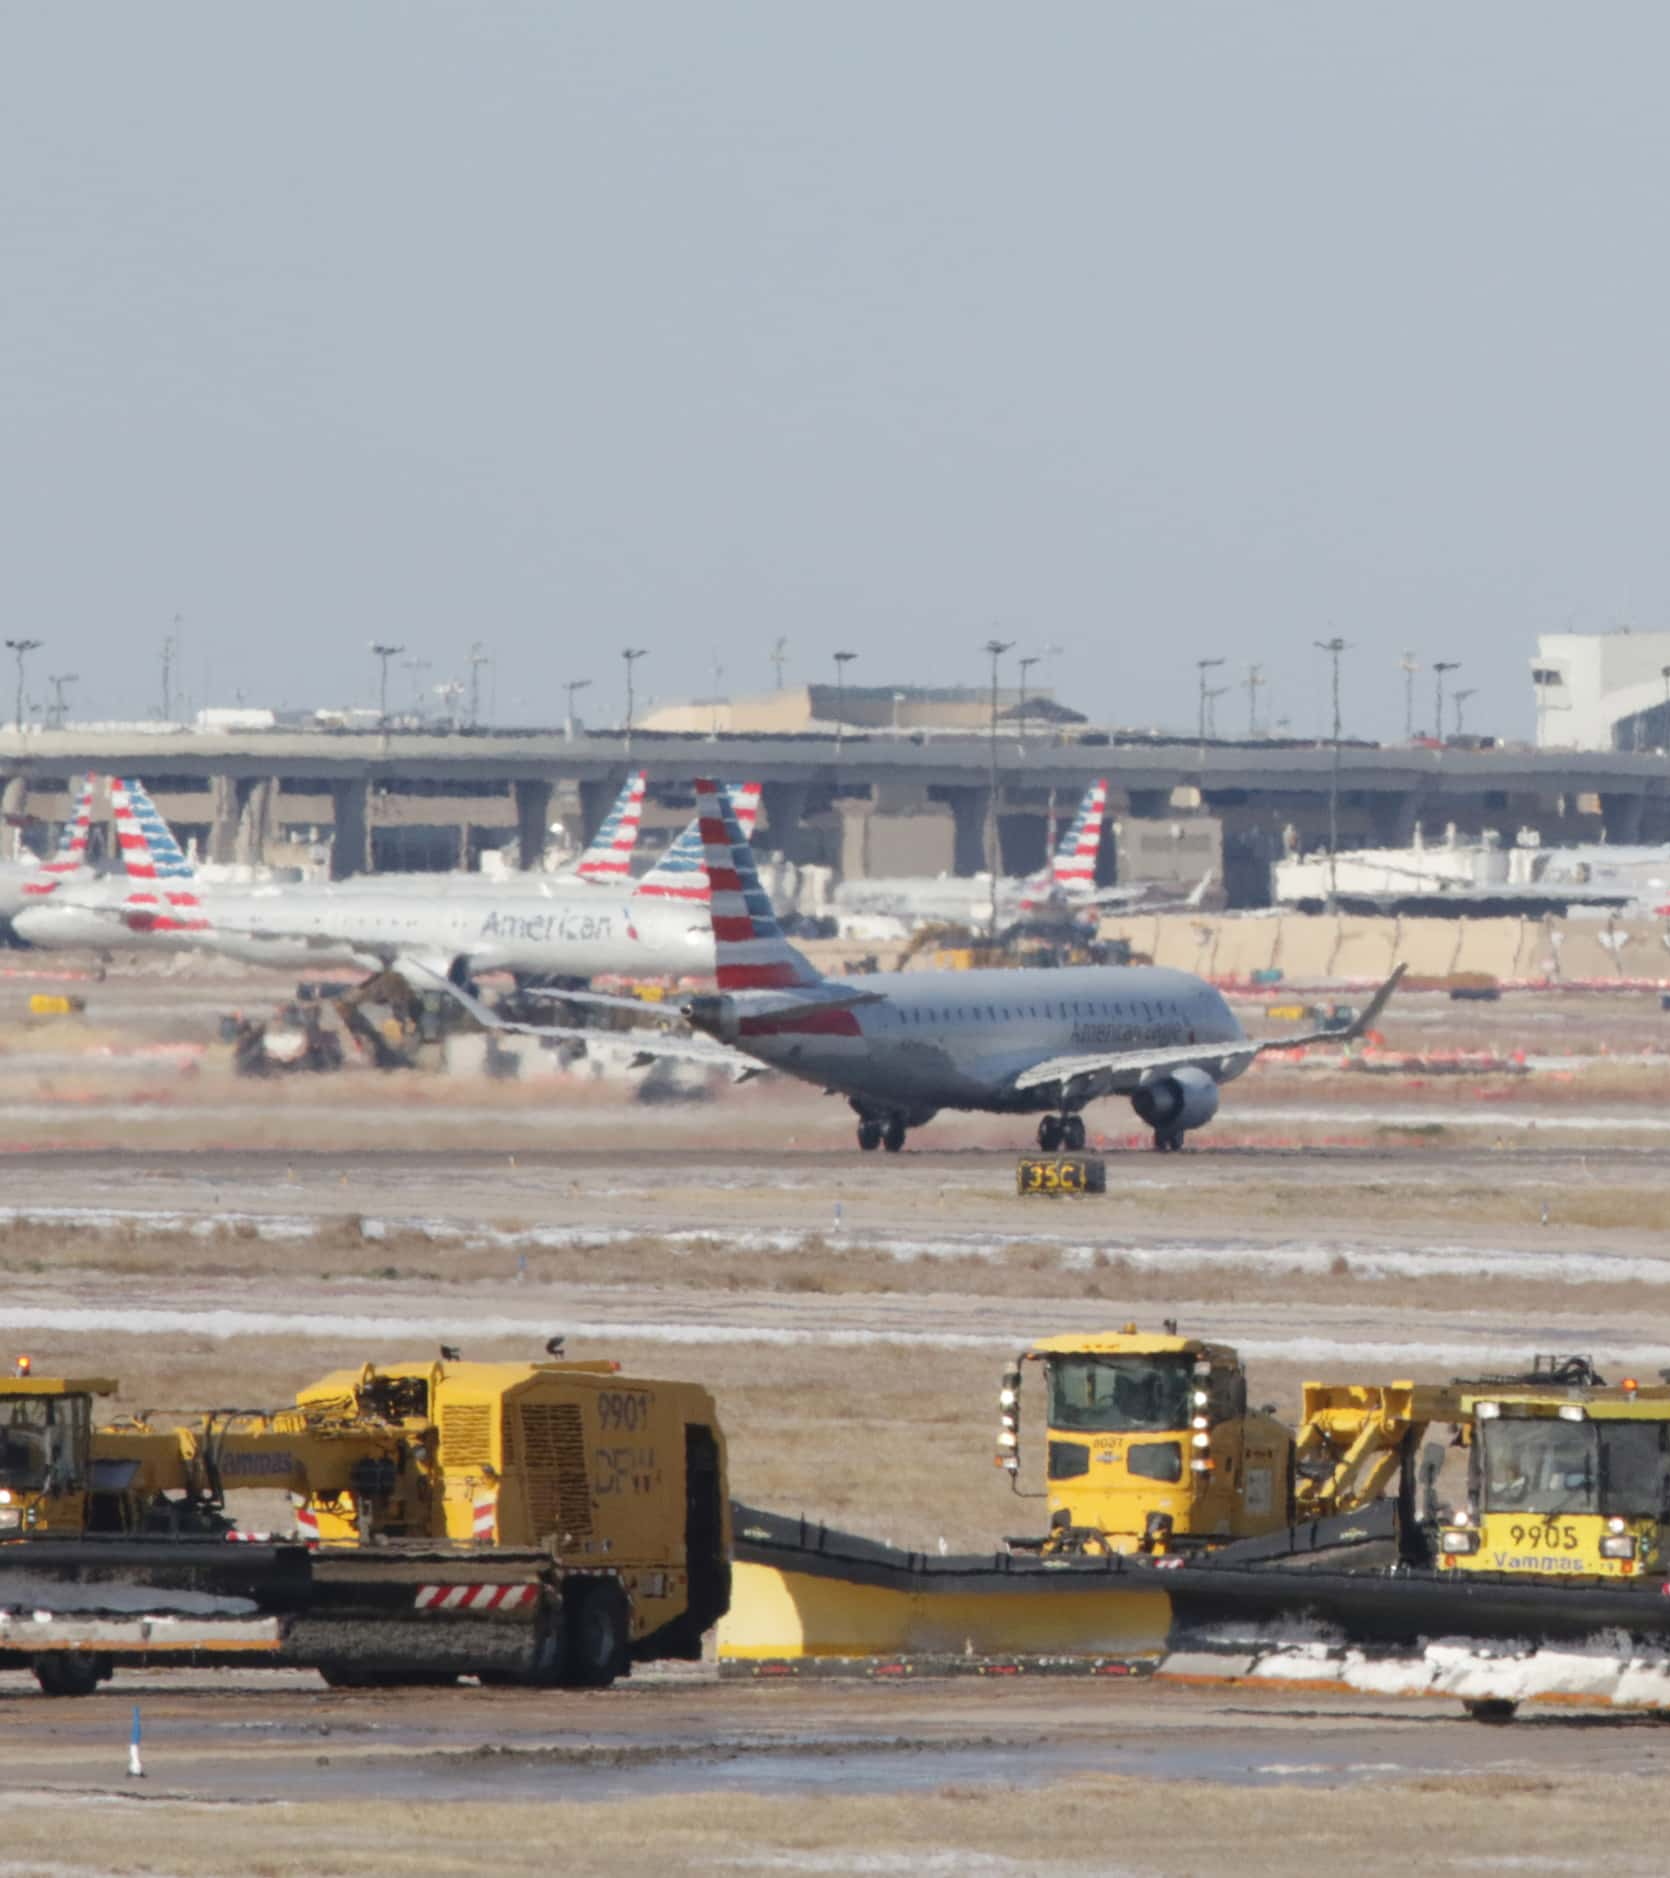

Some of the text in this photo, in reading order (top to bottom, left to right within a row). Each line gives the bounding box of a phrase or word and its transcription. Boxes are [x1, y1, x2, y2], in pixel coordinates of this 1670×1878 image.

[480, 906, 612, 941] American
[1029, 1165, 1075, 1188] 35C
[597, 1391, 649, 1431] 9901
[595, 1448, 658, 1494] DFW
[1510, 1524, 1578, 1550] 9905
[1493, 1552, 1584, 1571] Vammas
